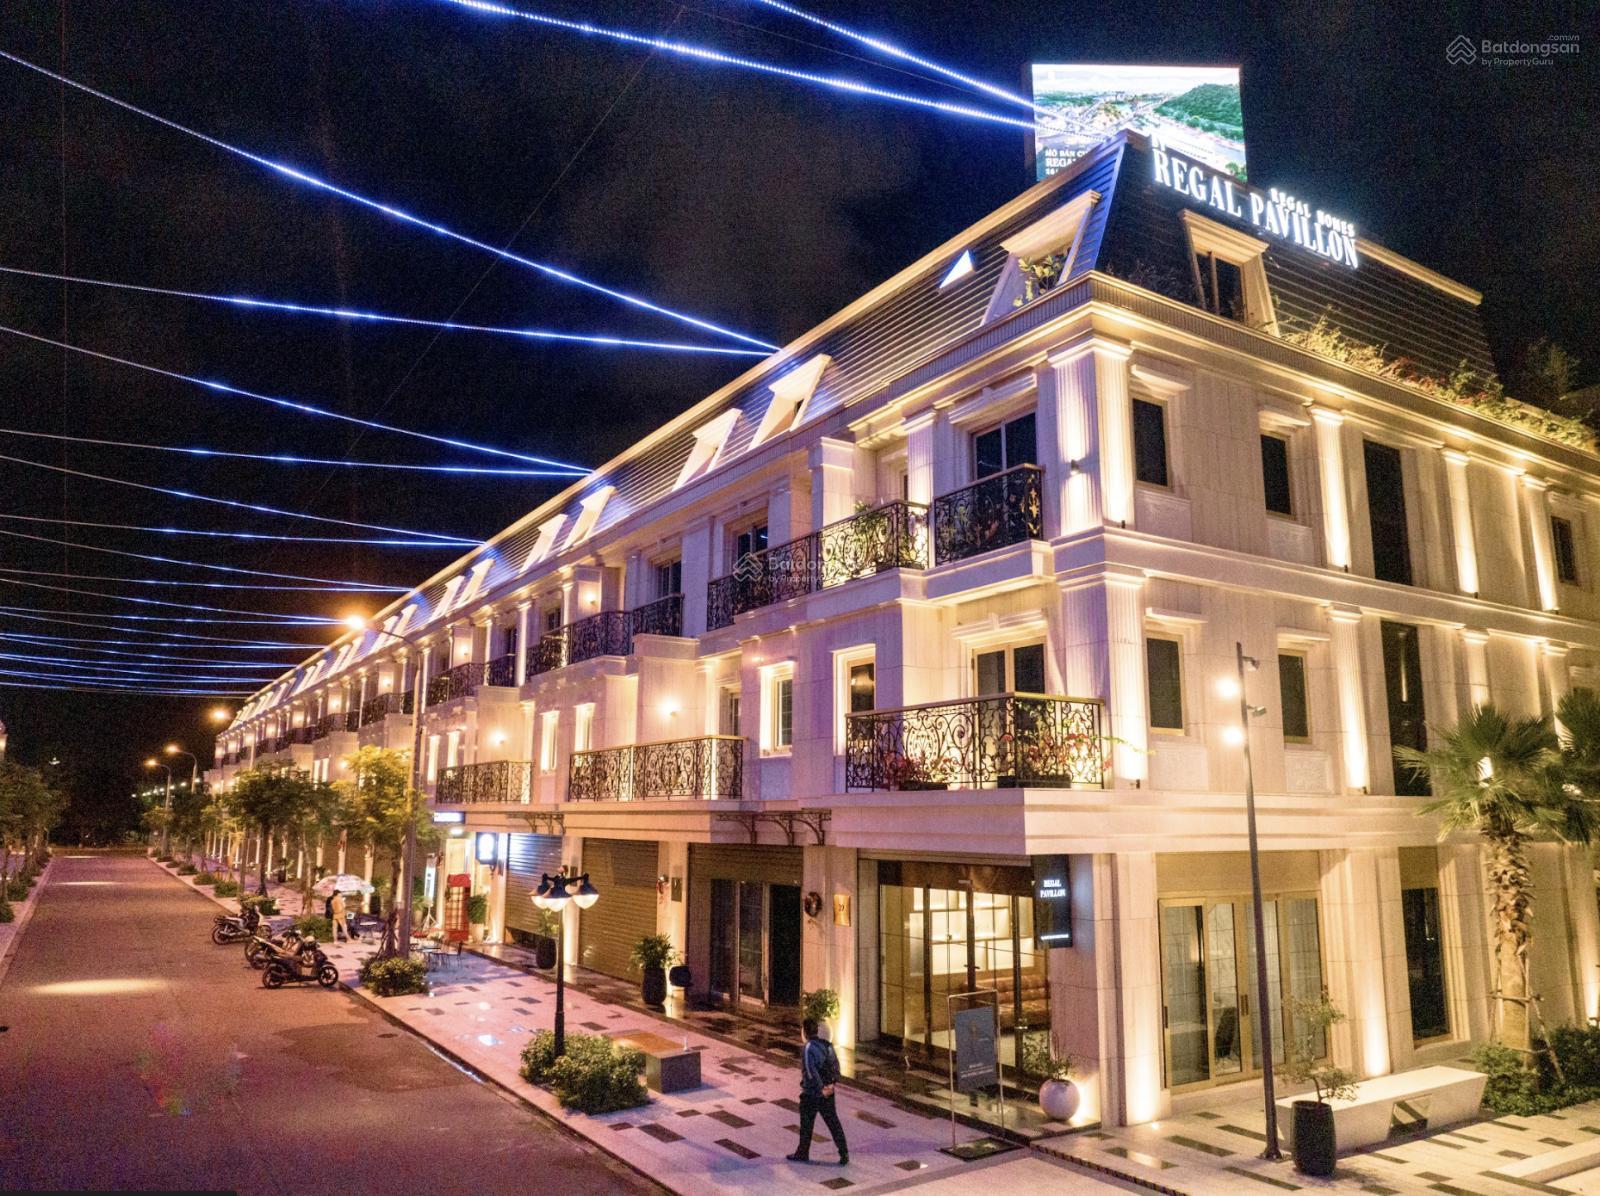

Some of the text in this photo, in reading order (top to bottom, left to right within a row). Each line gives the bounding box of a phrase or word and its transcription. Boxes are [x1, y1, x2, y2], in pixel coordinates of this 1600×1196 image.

[1152, 147, 1359, 269] REGAL PAVILLON
[1270, 187, 1312, 219] REGAL
